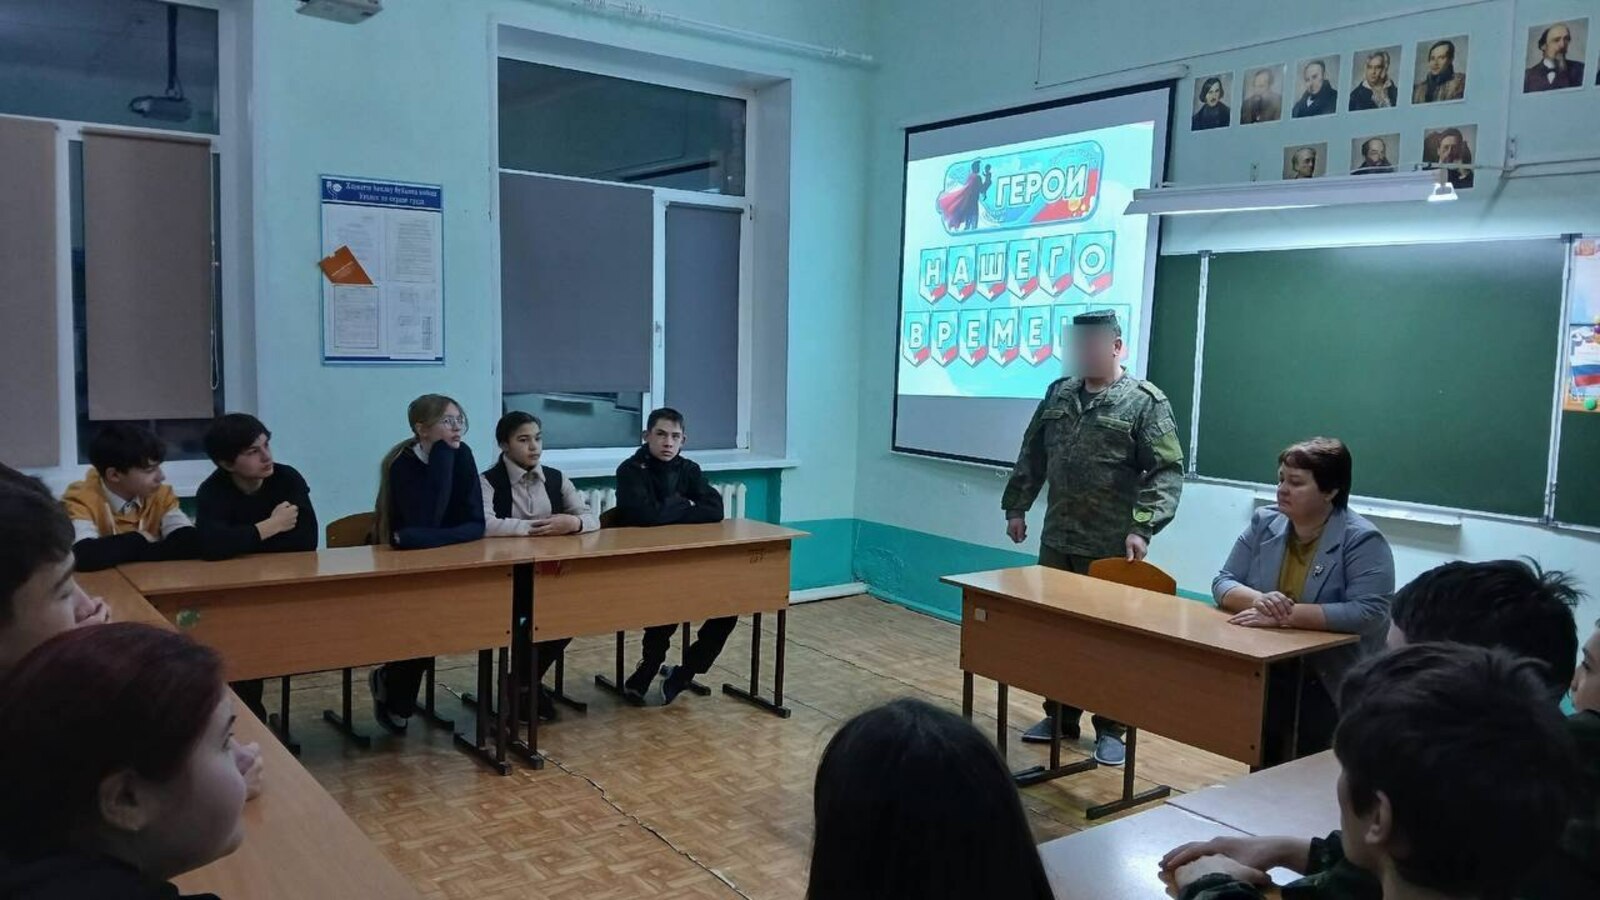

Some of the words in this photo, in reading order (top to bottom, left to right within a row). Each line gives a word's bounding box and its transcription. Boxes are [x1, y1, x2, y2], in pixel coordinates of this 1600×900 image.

[995, 163, 1088, 208] ГЕРОИ
[924, 242, 1107, 287] НАШЕГО
[908, 316, 1070, 349] ВРЕМЕ
